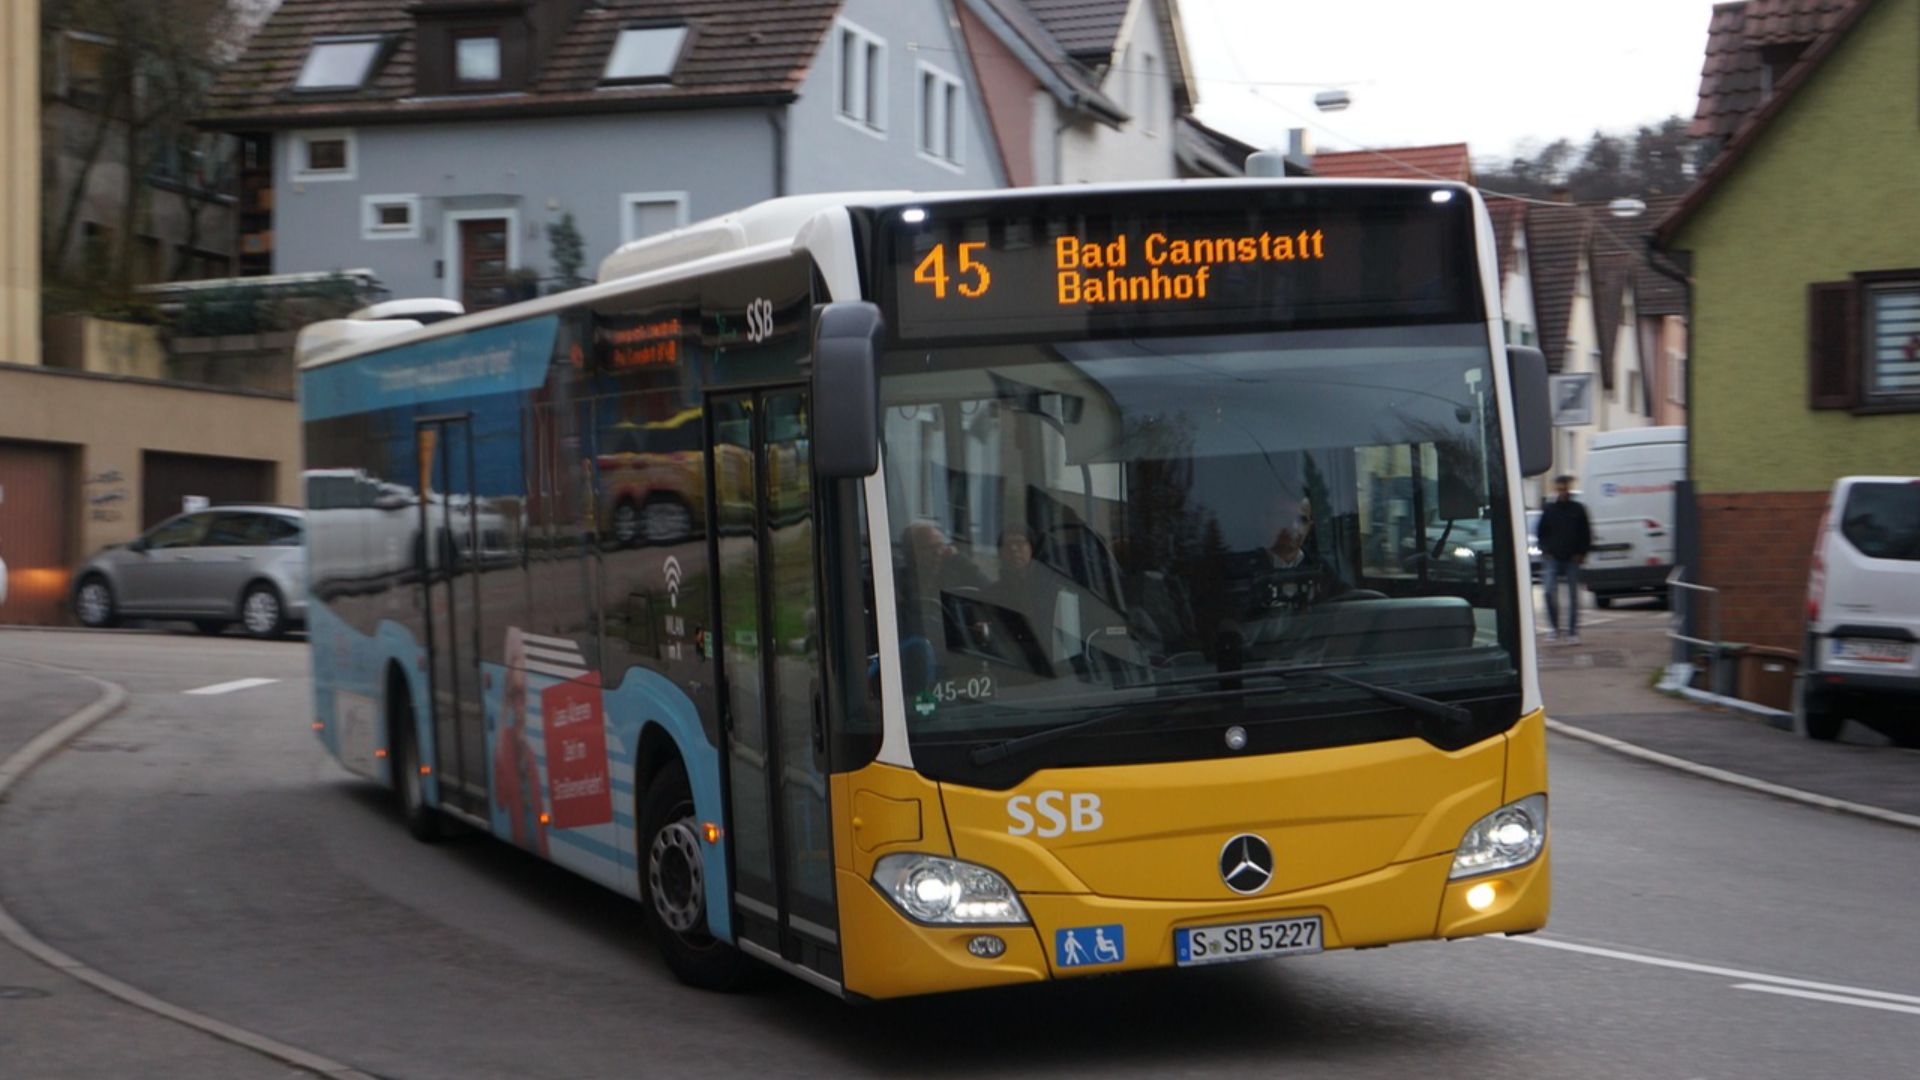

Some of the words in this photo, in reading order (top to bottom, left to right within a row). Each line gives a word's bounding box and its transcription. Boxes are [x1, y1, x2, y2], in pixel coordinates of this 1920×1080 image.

[1056, 234, 1127, 269] Bad
[1145, 229, 1325, 264] Cannstatt
[914, 241, 991, 298] 45
[1057, 266, 1210, 304] Bahnhof
[746, 297, 774, 343] SSB
[932, 676, 992, 702] 45-02
[1007, 789, 1104, 838] SSB
[1192, 932, 1207, 957] S
[1224, 927, 1254, 953] SB
[1259, 921, 1317, 950] 5227
